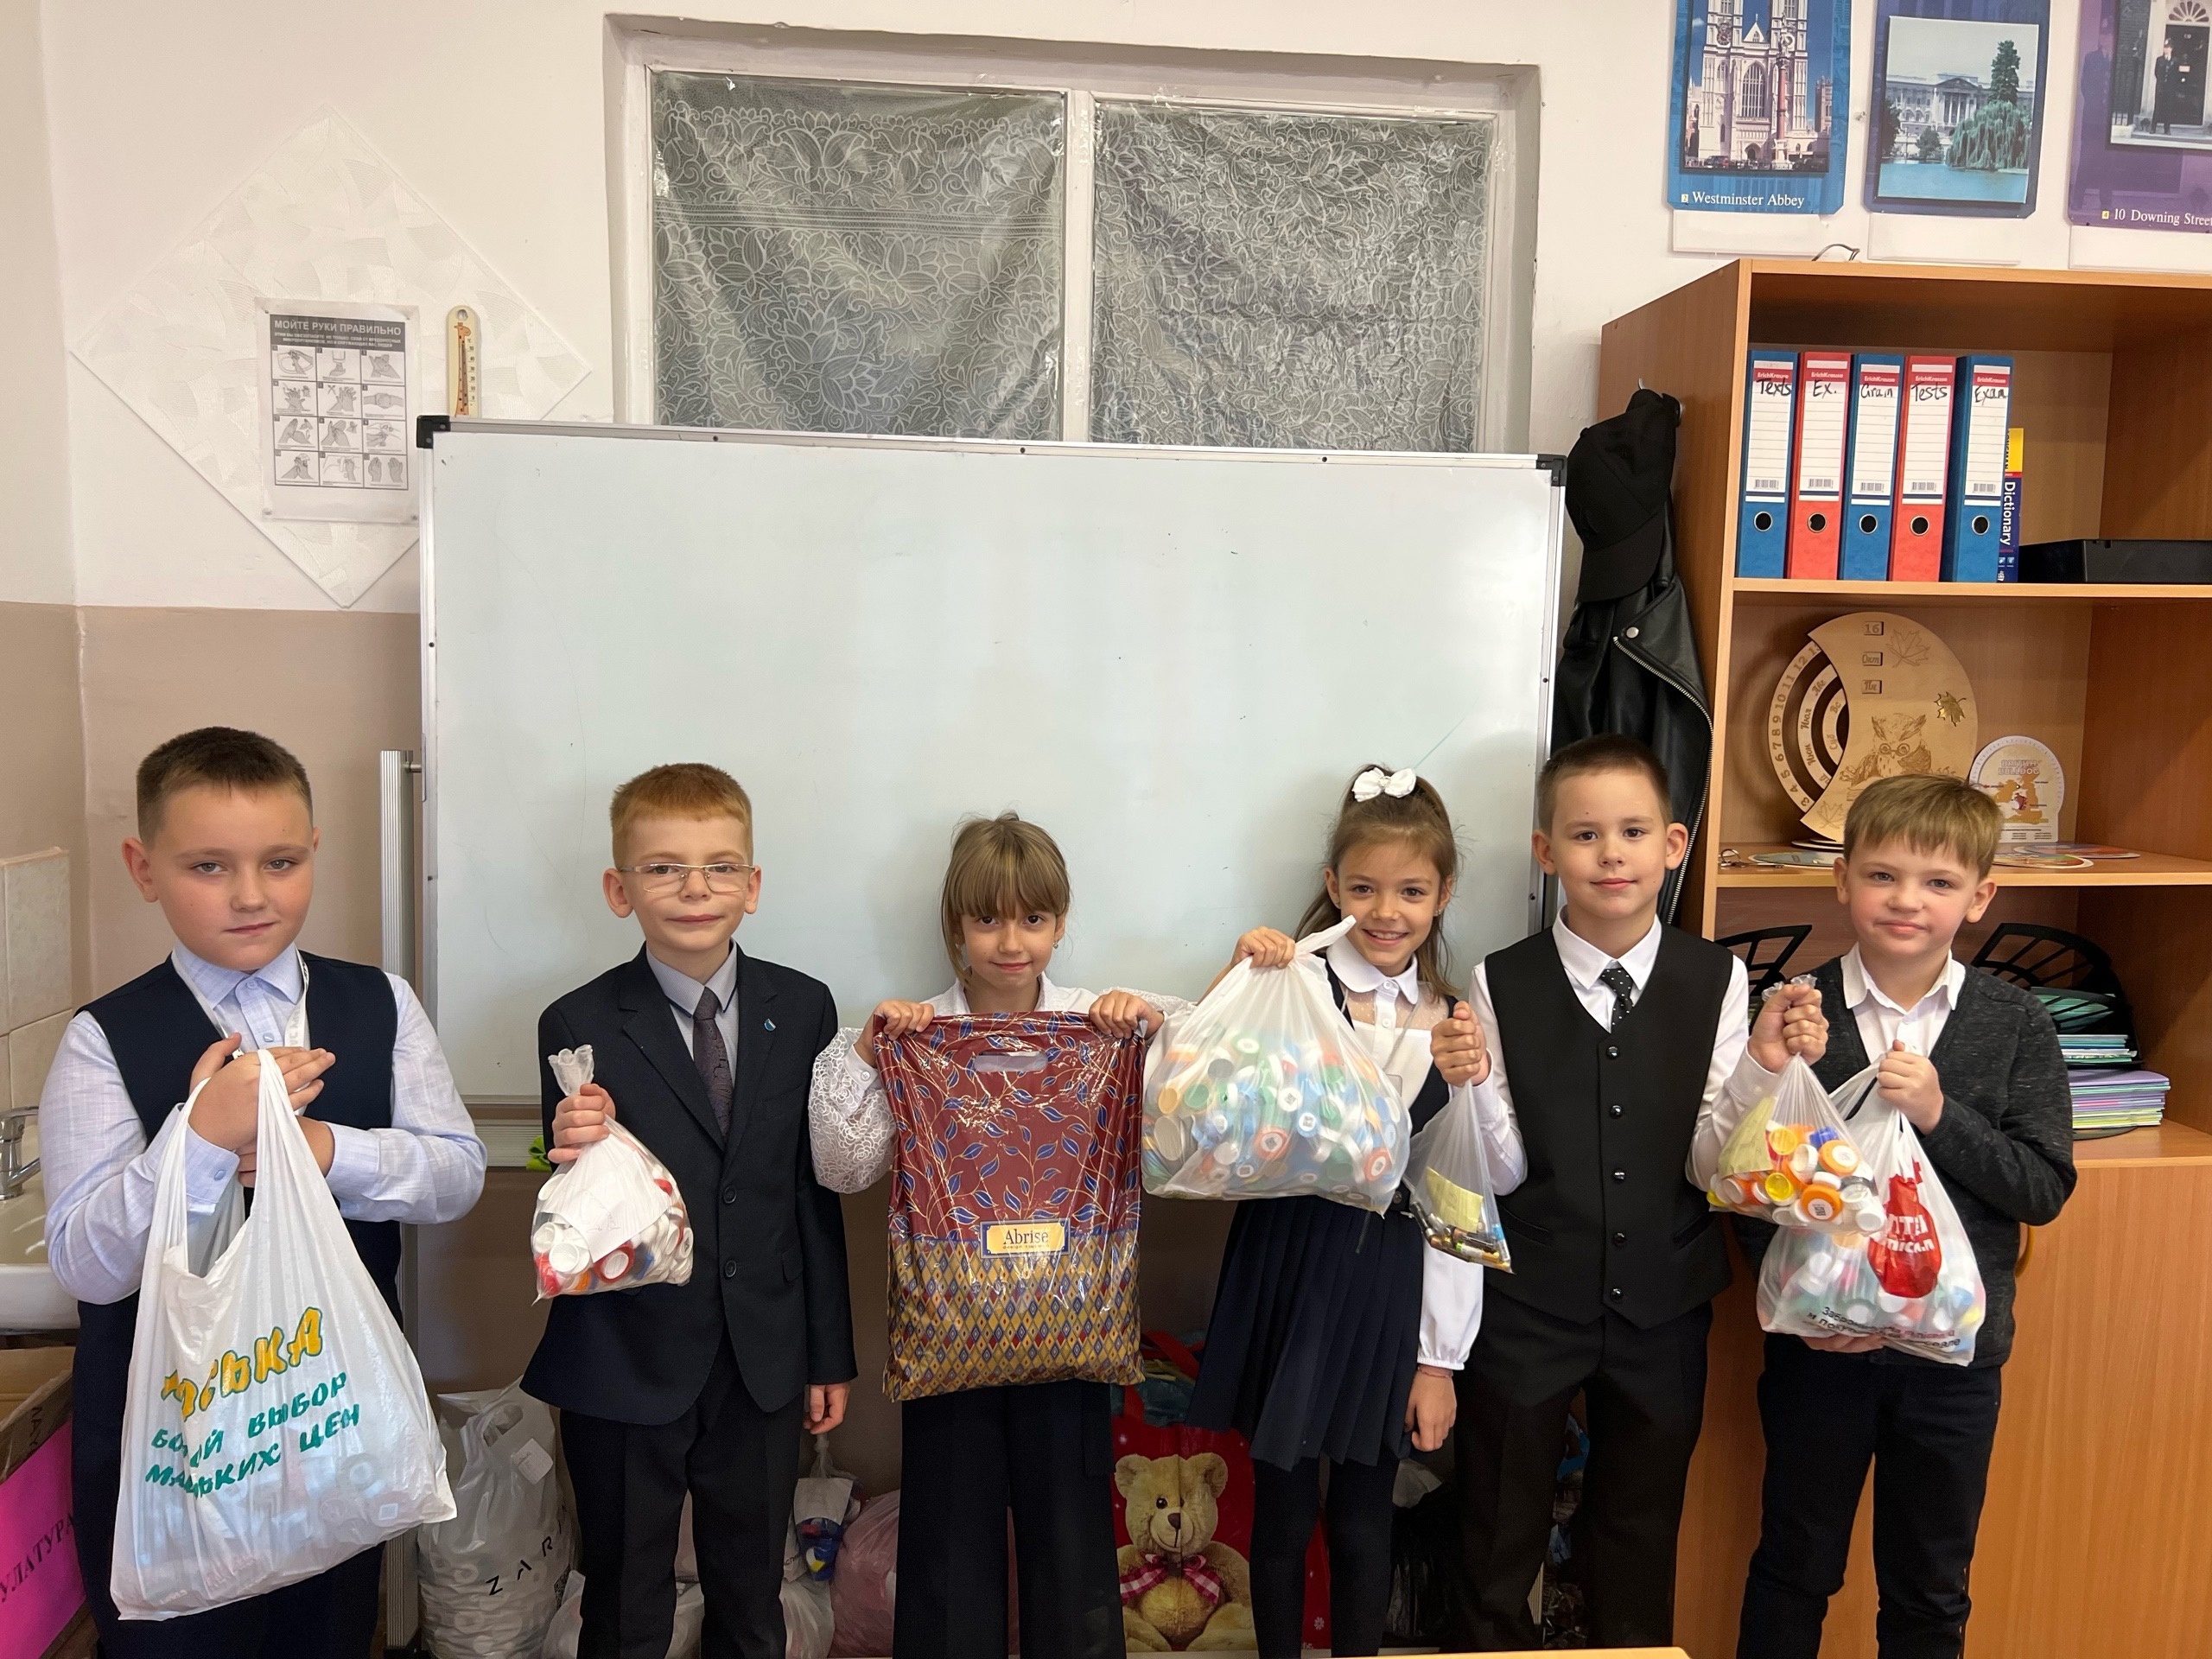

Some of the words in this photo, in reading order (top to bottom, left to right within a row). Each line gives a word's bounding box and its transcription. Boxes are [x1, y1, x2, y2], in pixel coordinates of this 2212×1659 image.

[1692, 192, 1764, 206] Westminster
[1767, 194, 1805, 209] Abbey
[2114, 208, 2126, 220] 10
[2131, 209, 2180, 226] Downing
[274, 319, 309, 330] МОЙТЕ
[312, 321, 337, 332] РУКИ
[340, 323, 402, 336] ПРАВИЛЬНО
[1756, 378, 1792, 397] Texts
[1812, 379, 1837, 398] Ex.
[1910, 381, 1948, 402] Tests
[1974, 385, 2008, 406] Exam
[1999, 481, 2016, 546] Dictionary
[1865, 623, 1880, 634] 16
[1793, 656, 1808, 672] 12
[1782, 674, 1796, 690] 11
[1775, 694, 1786, 710] 10
[1830, 701, 1840, 714] Вс
[1800, 708, 1812, 729] Июл
[1772, 742, 1782, 751] 7
[1803, 743, 1816, 766] Июн
[1781, 769, 1790, 779] 5
[1789, 785, 1799, 793] 4
[1801, 797, 1810, 806] 3
[1003, 1228, 1049, 1245] Abrise
[248, 1372, 346, 1439] ВЫБОР
[300, 1403, 359, 1452] ЦЕН
